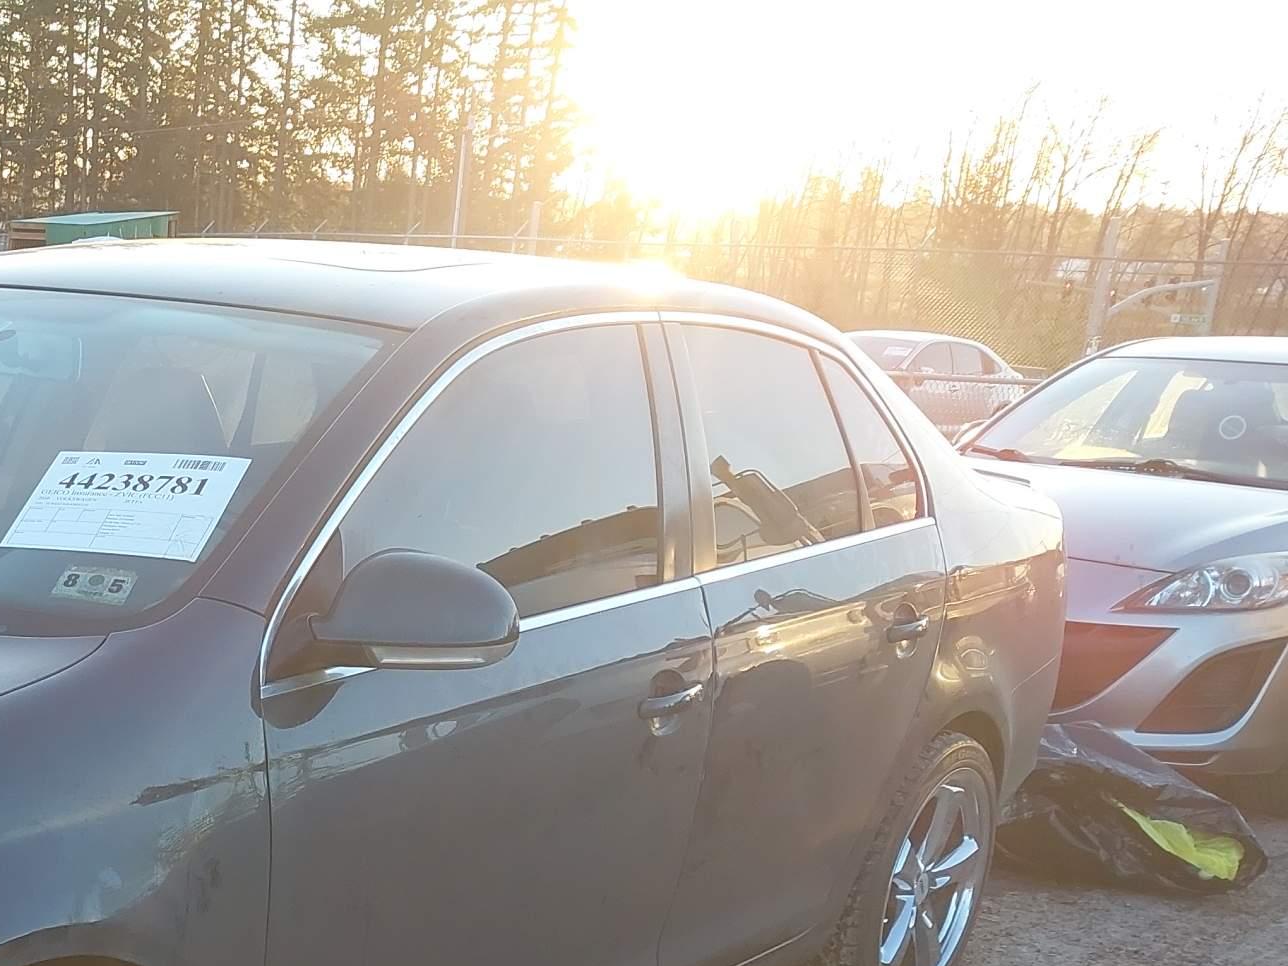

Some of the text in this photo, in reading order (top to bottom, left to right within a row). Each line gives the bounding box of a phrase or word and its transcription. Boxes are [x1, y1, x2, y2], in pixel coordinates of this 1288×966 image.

[58, 472, 209, 497] 44238781
[63, 573, 81, 588] 8
[108, 579, 126, 594] 5
